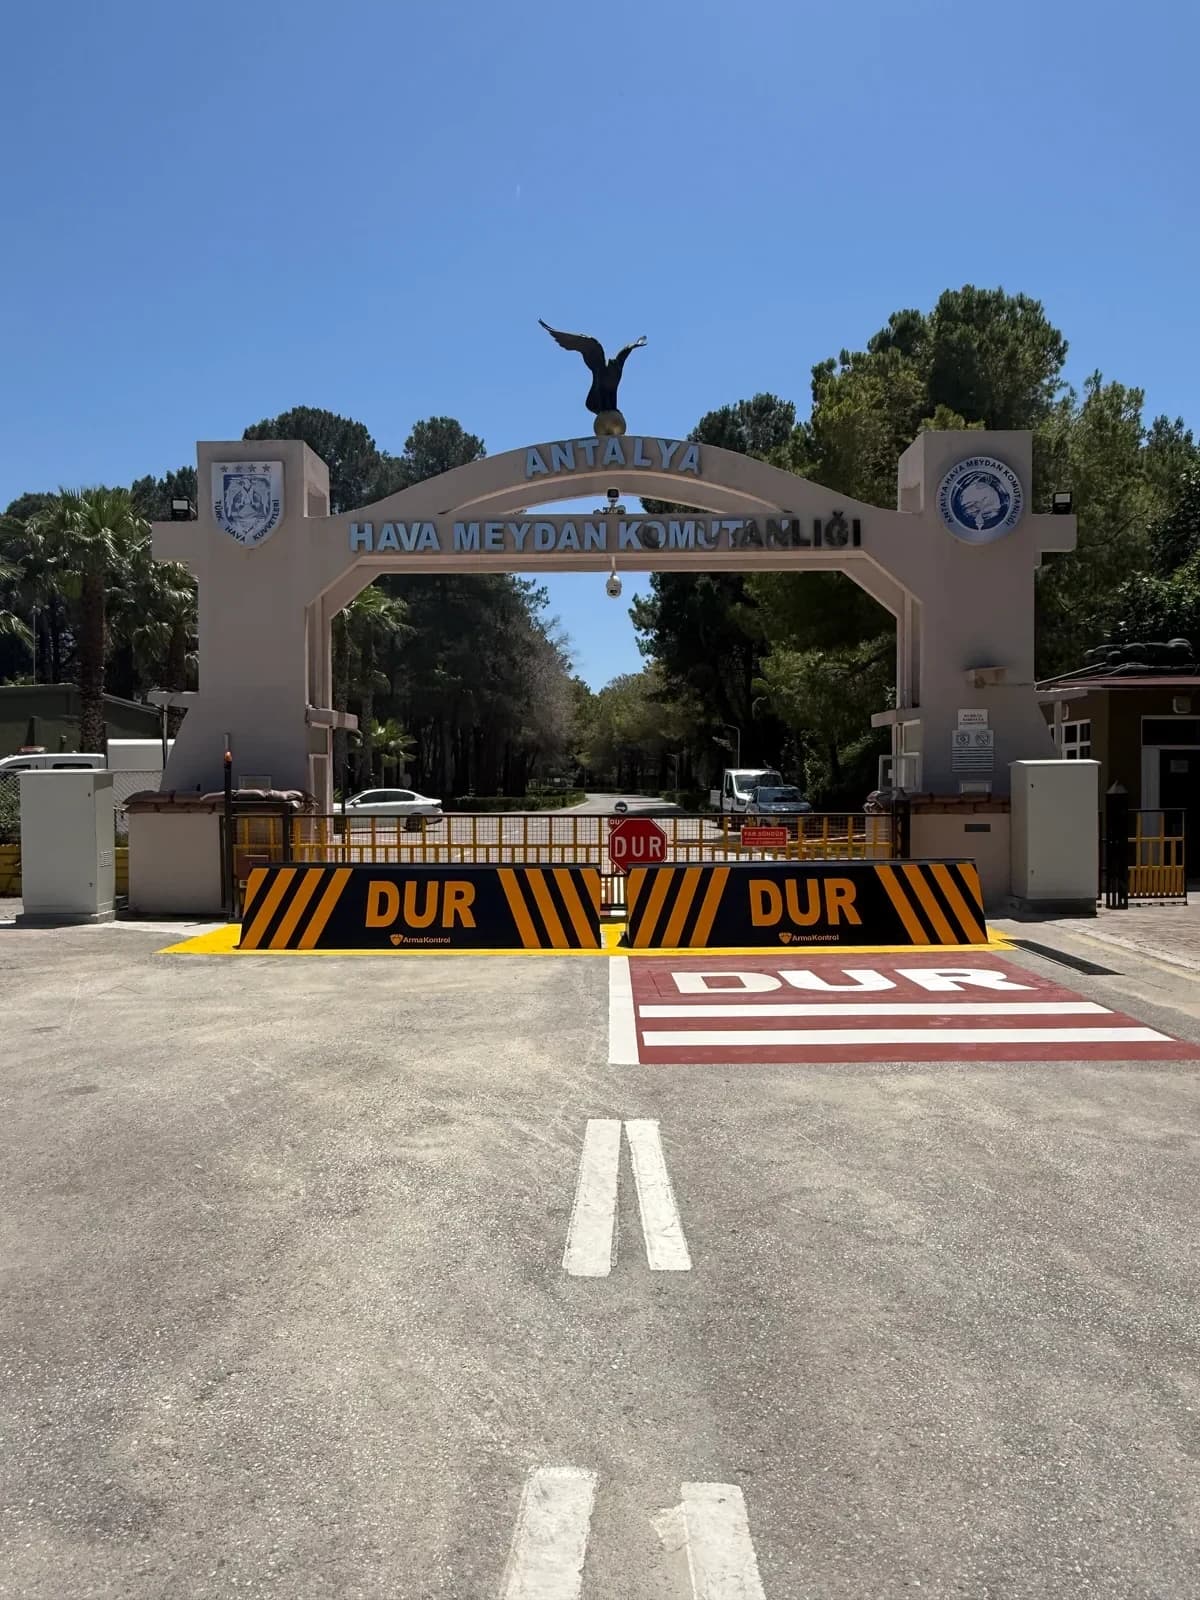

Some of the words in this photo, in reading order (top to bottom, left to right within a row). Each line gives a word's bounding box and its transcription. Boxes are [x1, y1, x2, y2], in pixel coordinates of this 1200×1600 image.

[525, 437, 701, 478] ANTALYA
[966, 459, 1004, 472] MEYDAN
[944, 465, 965, 485] HAVA
[939, 486, 954, 523] ANTALYA
[224, 526, 246, 542] HAVA
[350, 520, 441, 551] HAVA
[453, 520, 607, 551] MEYDAN
[617, 511, 862, 550] KOMUTANLIĞI
[614, 836, 662, 858] DUR
[365, 880, 477, 928] DUR
[748, 878, 863, 926] DUR
[671, 968, 1041, 994] DUR
